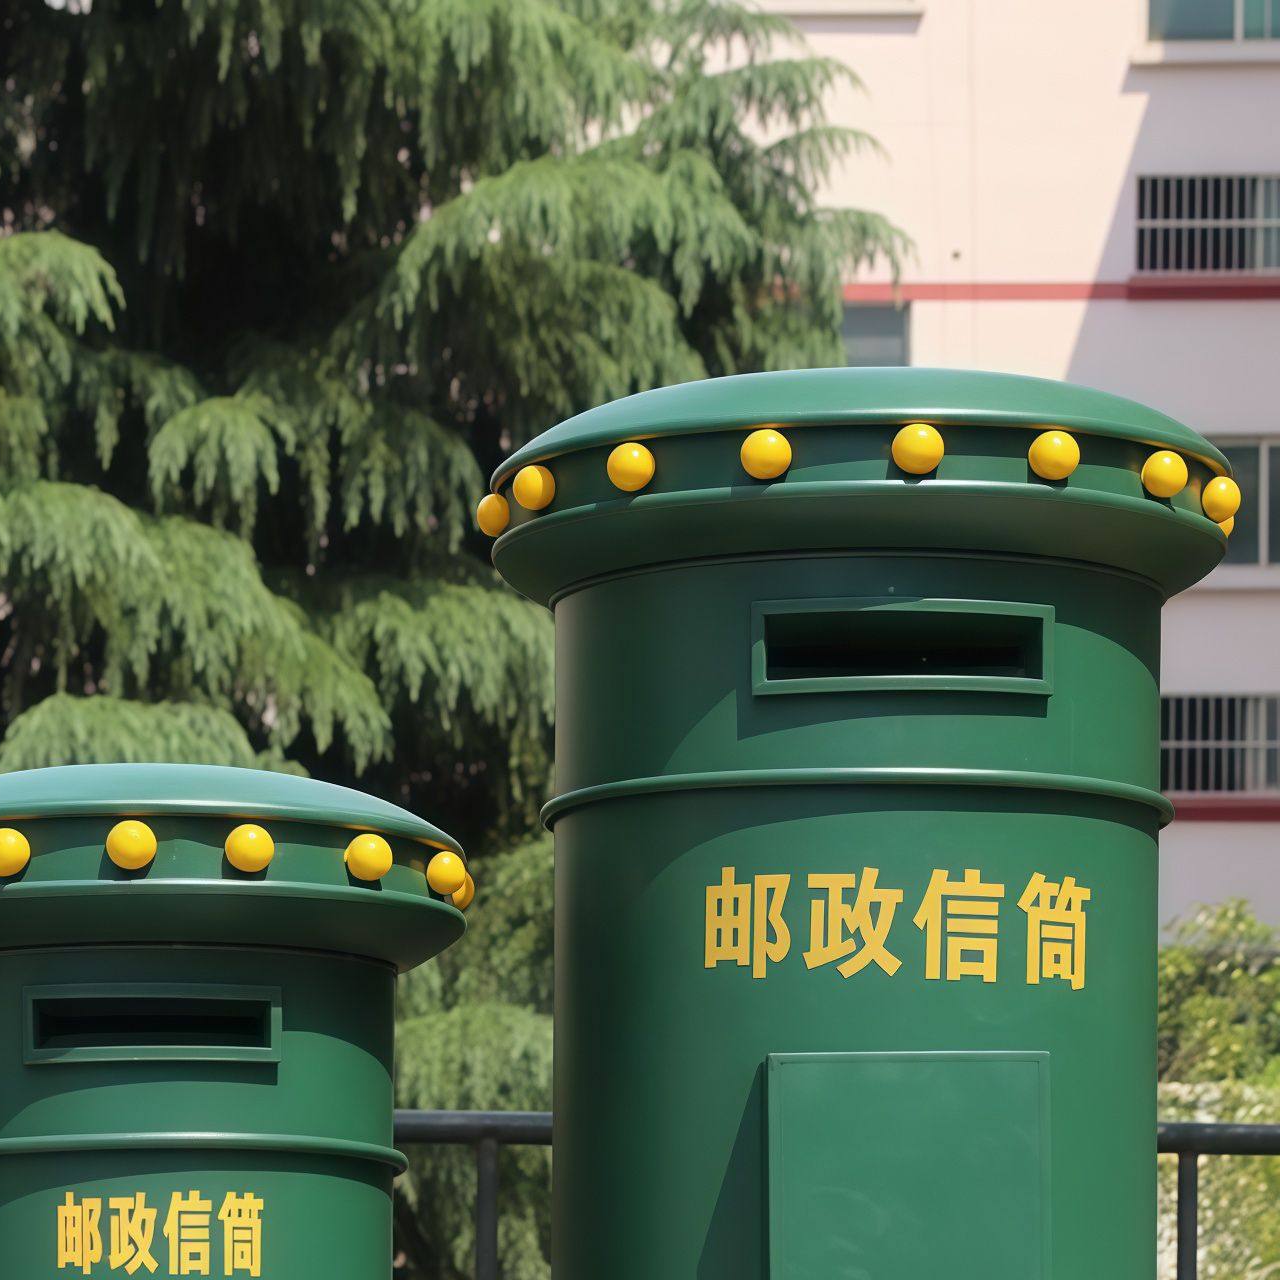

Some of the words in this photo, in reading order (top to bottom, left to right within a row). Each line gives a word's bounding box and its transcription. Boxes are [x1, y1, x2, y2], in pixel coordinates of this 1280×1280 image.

[704, 866, 1091, 991] 邮政信筒
[56, 1189, 265, 1278] 邮政信筒
